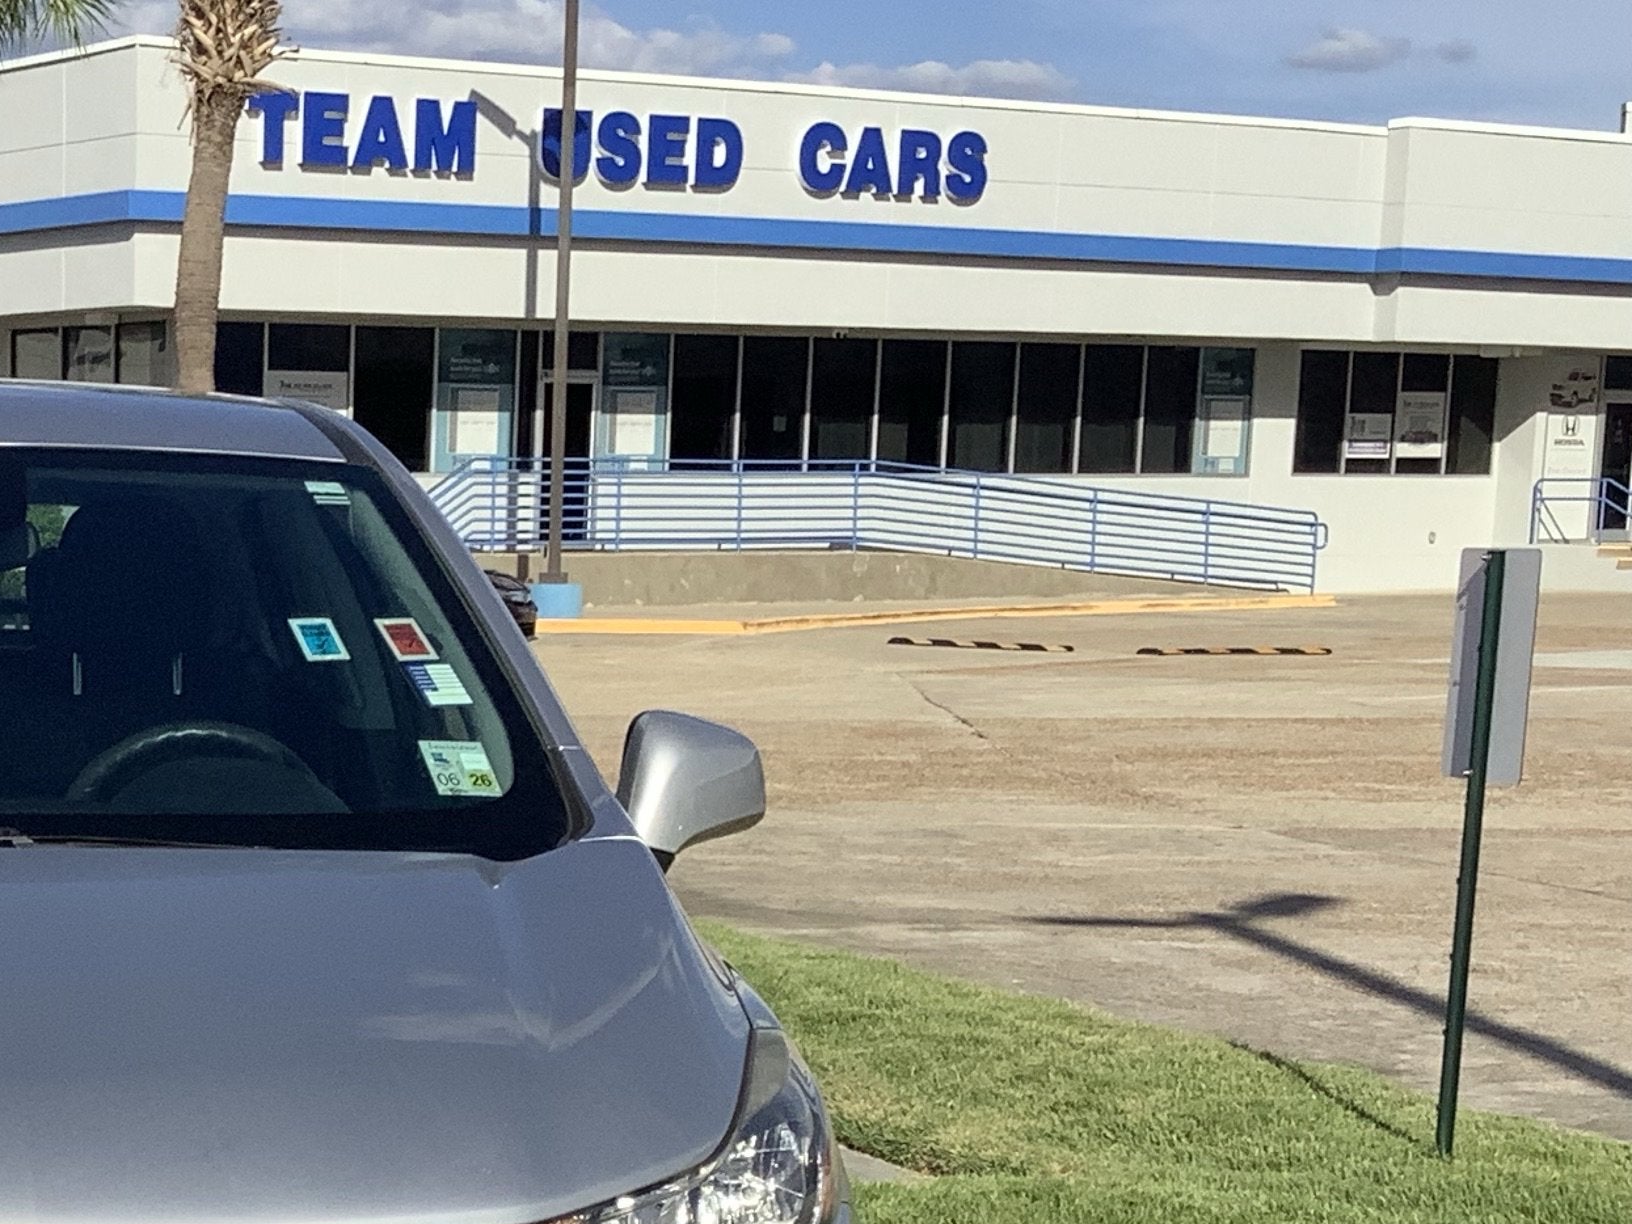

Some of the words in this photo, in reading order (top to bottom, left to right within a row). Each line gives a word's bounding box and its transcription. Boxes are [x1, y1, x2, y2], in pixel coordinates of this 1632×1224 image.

[248, 90, 478, 177] TEAM
[541, 107, 744, 190] USED
[798, 121, 989, 202] CARS
[436, 772, 461, 786] 06
[469, 773, 493, 787] 26
